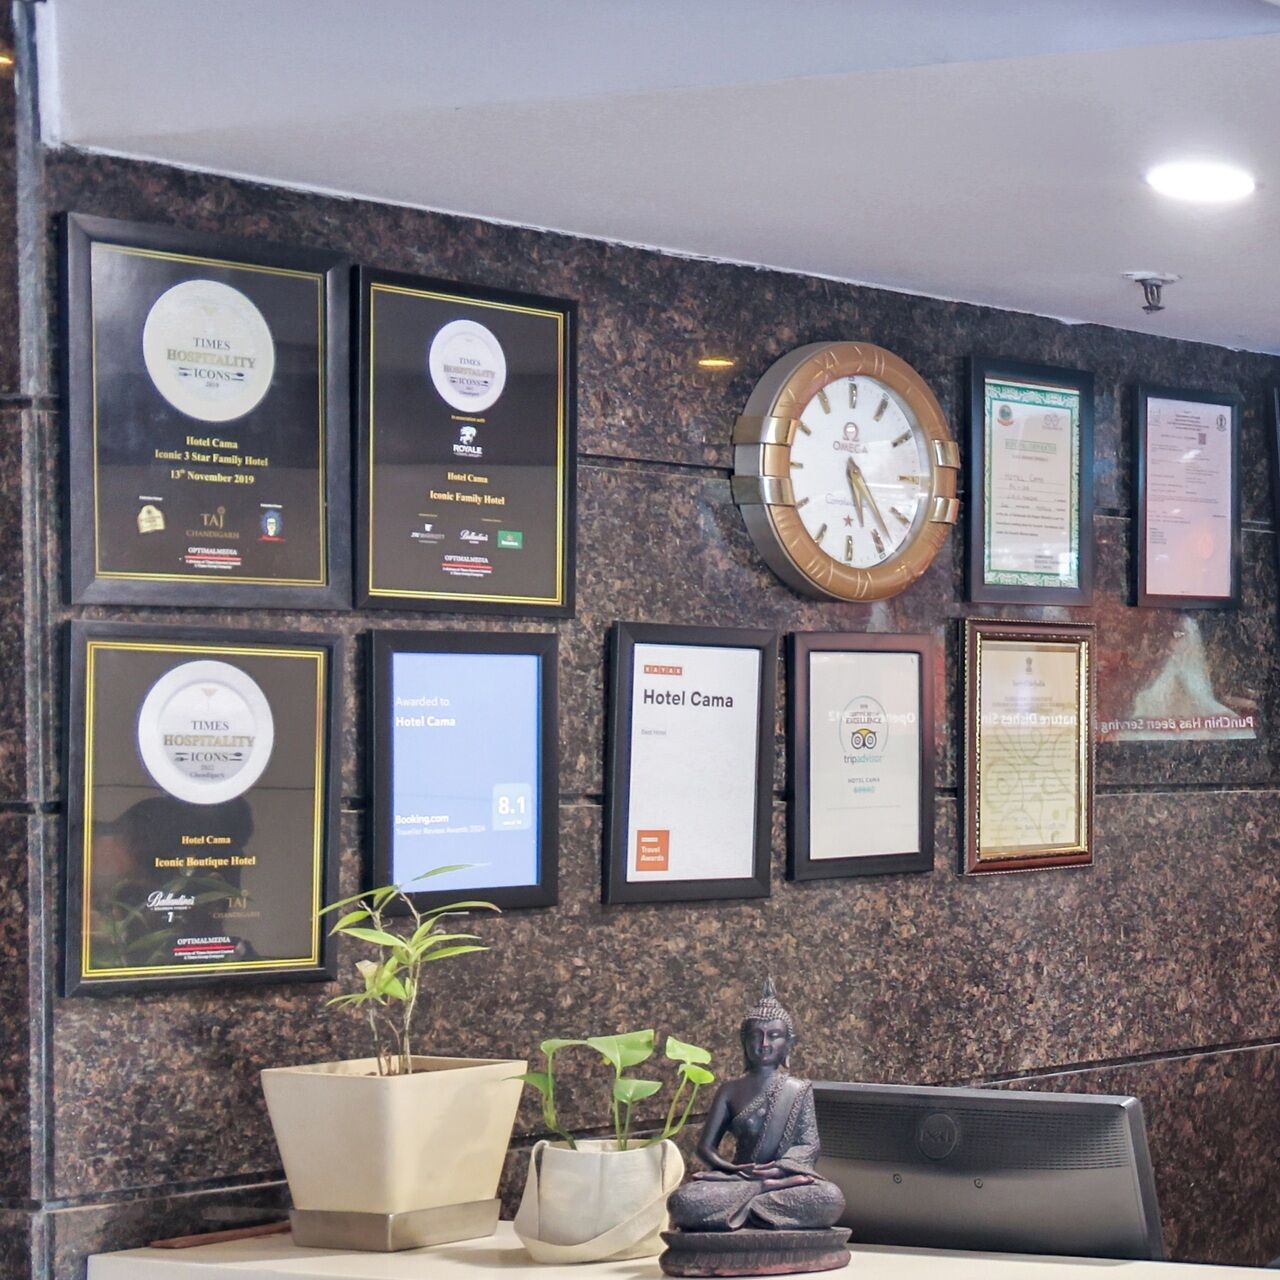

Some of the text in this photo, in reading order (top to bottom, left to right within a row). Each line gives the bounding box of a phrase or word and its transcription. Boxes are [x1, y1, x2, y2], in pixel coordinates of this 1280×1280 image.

[193, 337, 231, 350] TIMES
[167, 349, 256, 368] HOSPITALITY
[194, 368, 231, 381] ICONS
[186, 436, 238, 449] Hotel Cama
[453, 444, 483, 454] ROYALE
[833, 441, 868, 454] OMEGA
[155, 449, 269, 467] Iconic 3 Star Family Hotel
[187, 471, 233, 483] November
[234, 474, 255, 484] 2019
[447, 472, 488, 483] Hotel Cama
[430, 490, 505, 505] Iconic Family Hotel
[645, 665, 681, 675] KAYAK
[396, 696, 450, 706] Awarded to
[643, 689, 734, 708] Hotel Cama
[191, 720, 230, 730] TIMES
[395, 716, 456, 727] Hotel Cama
[163, 734, 256, 747] HOSPITALITY
[191, 752, 229, 762] ICONS
[498, 796, 525, 815] 8.1
[395, 814, 449, 825] Booking.com
[182, 835, 231, 845] Hotel Cama
[155, 855, 256, 868] Iconic Boutique Hotel
[177, 936, 231, 945] OPTIMALMEDIA
